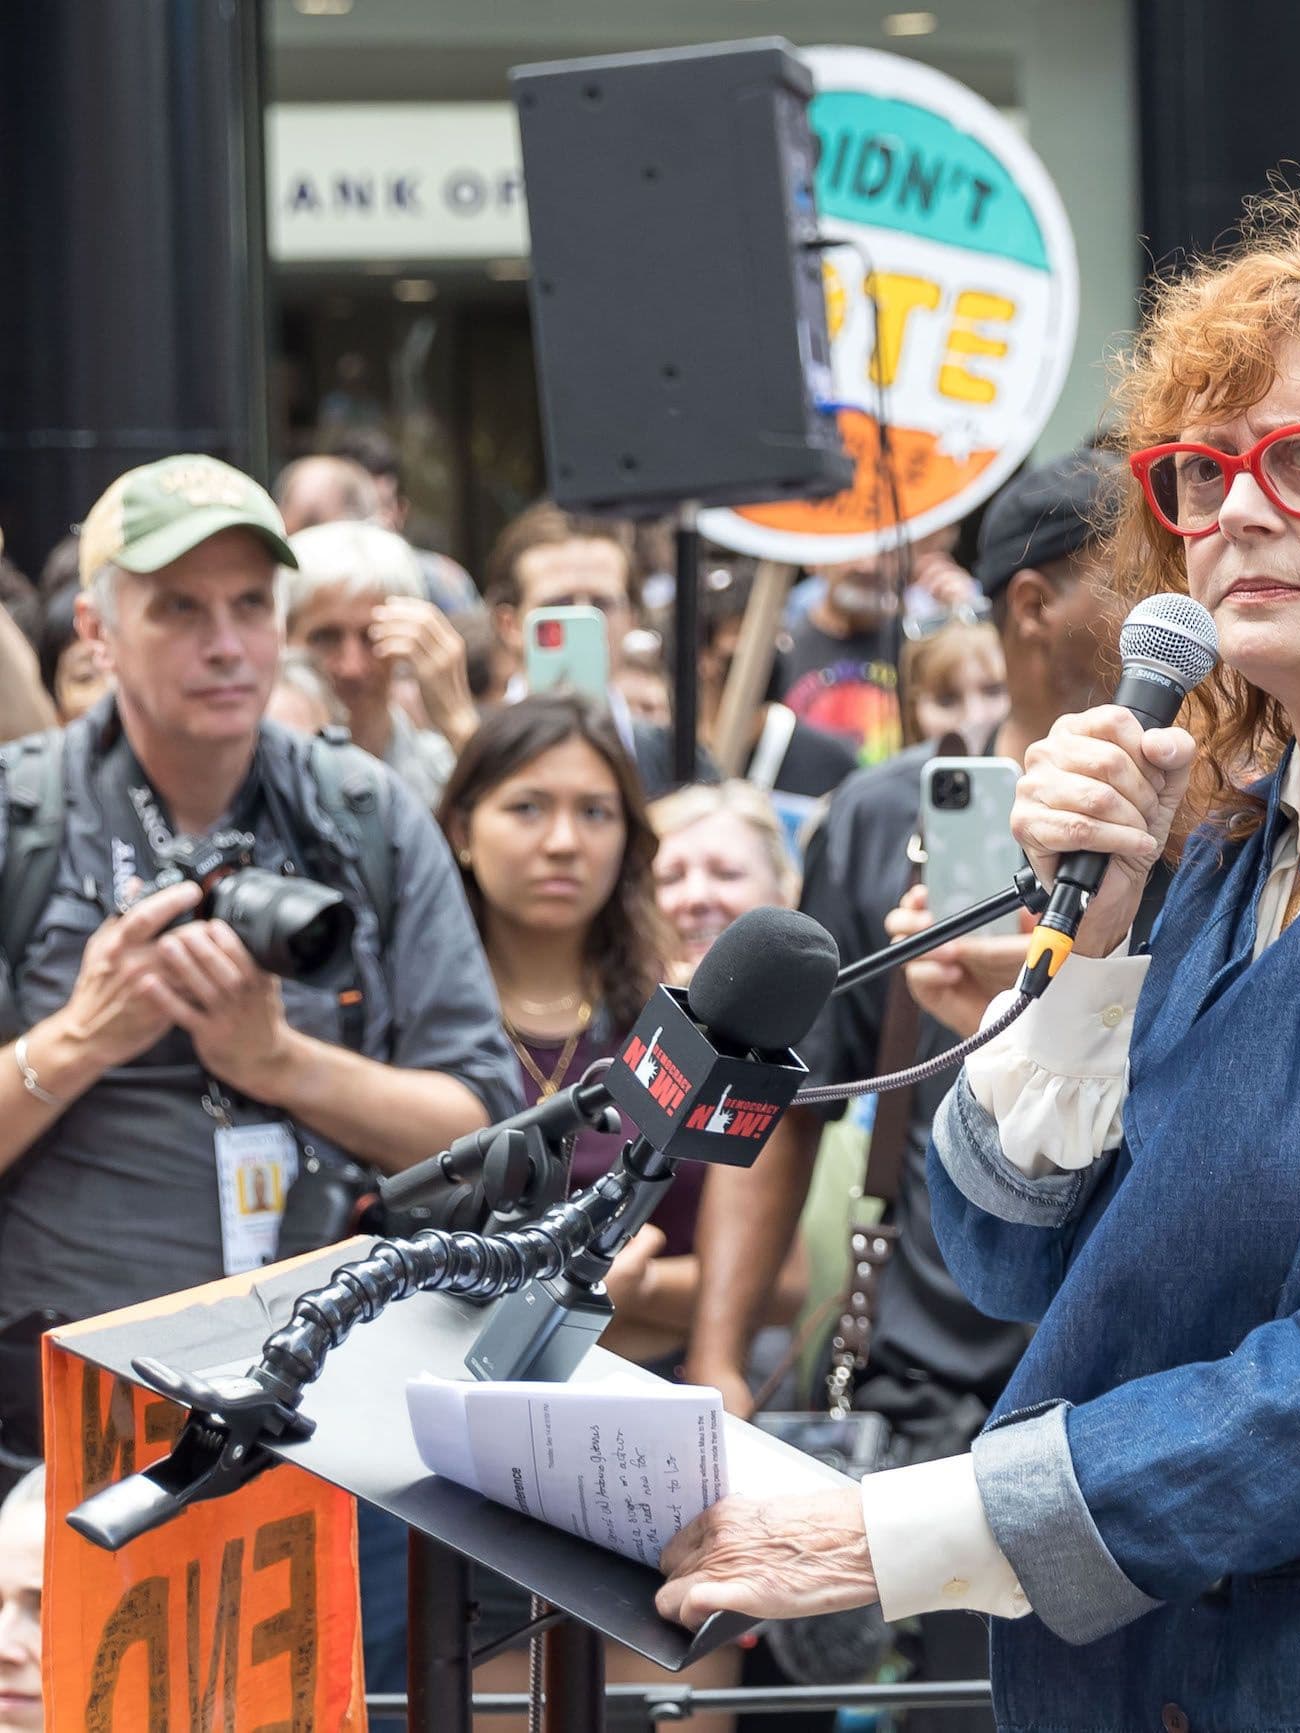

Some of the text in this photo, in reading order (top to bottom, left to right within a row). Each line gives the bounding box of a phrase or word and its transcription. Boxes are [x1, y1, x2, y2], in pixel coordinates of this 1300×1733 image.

[1136, 668, 1172, 688] SHURE
[653, 1044, 693, 1092] DEMOCRACY
[724, 1097, 780, 1116] DEMOCRACY
[511, 1467, 529, 1513] onference
